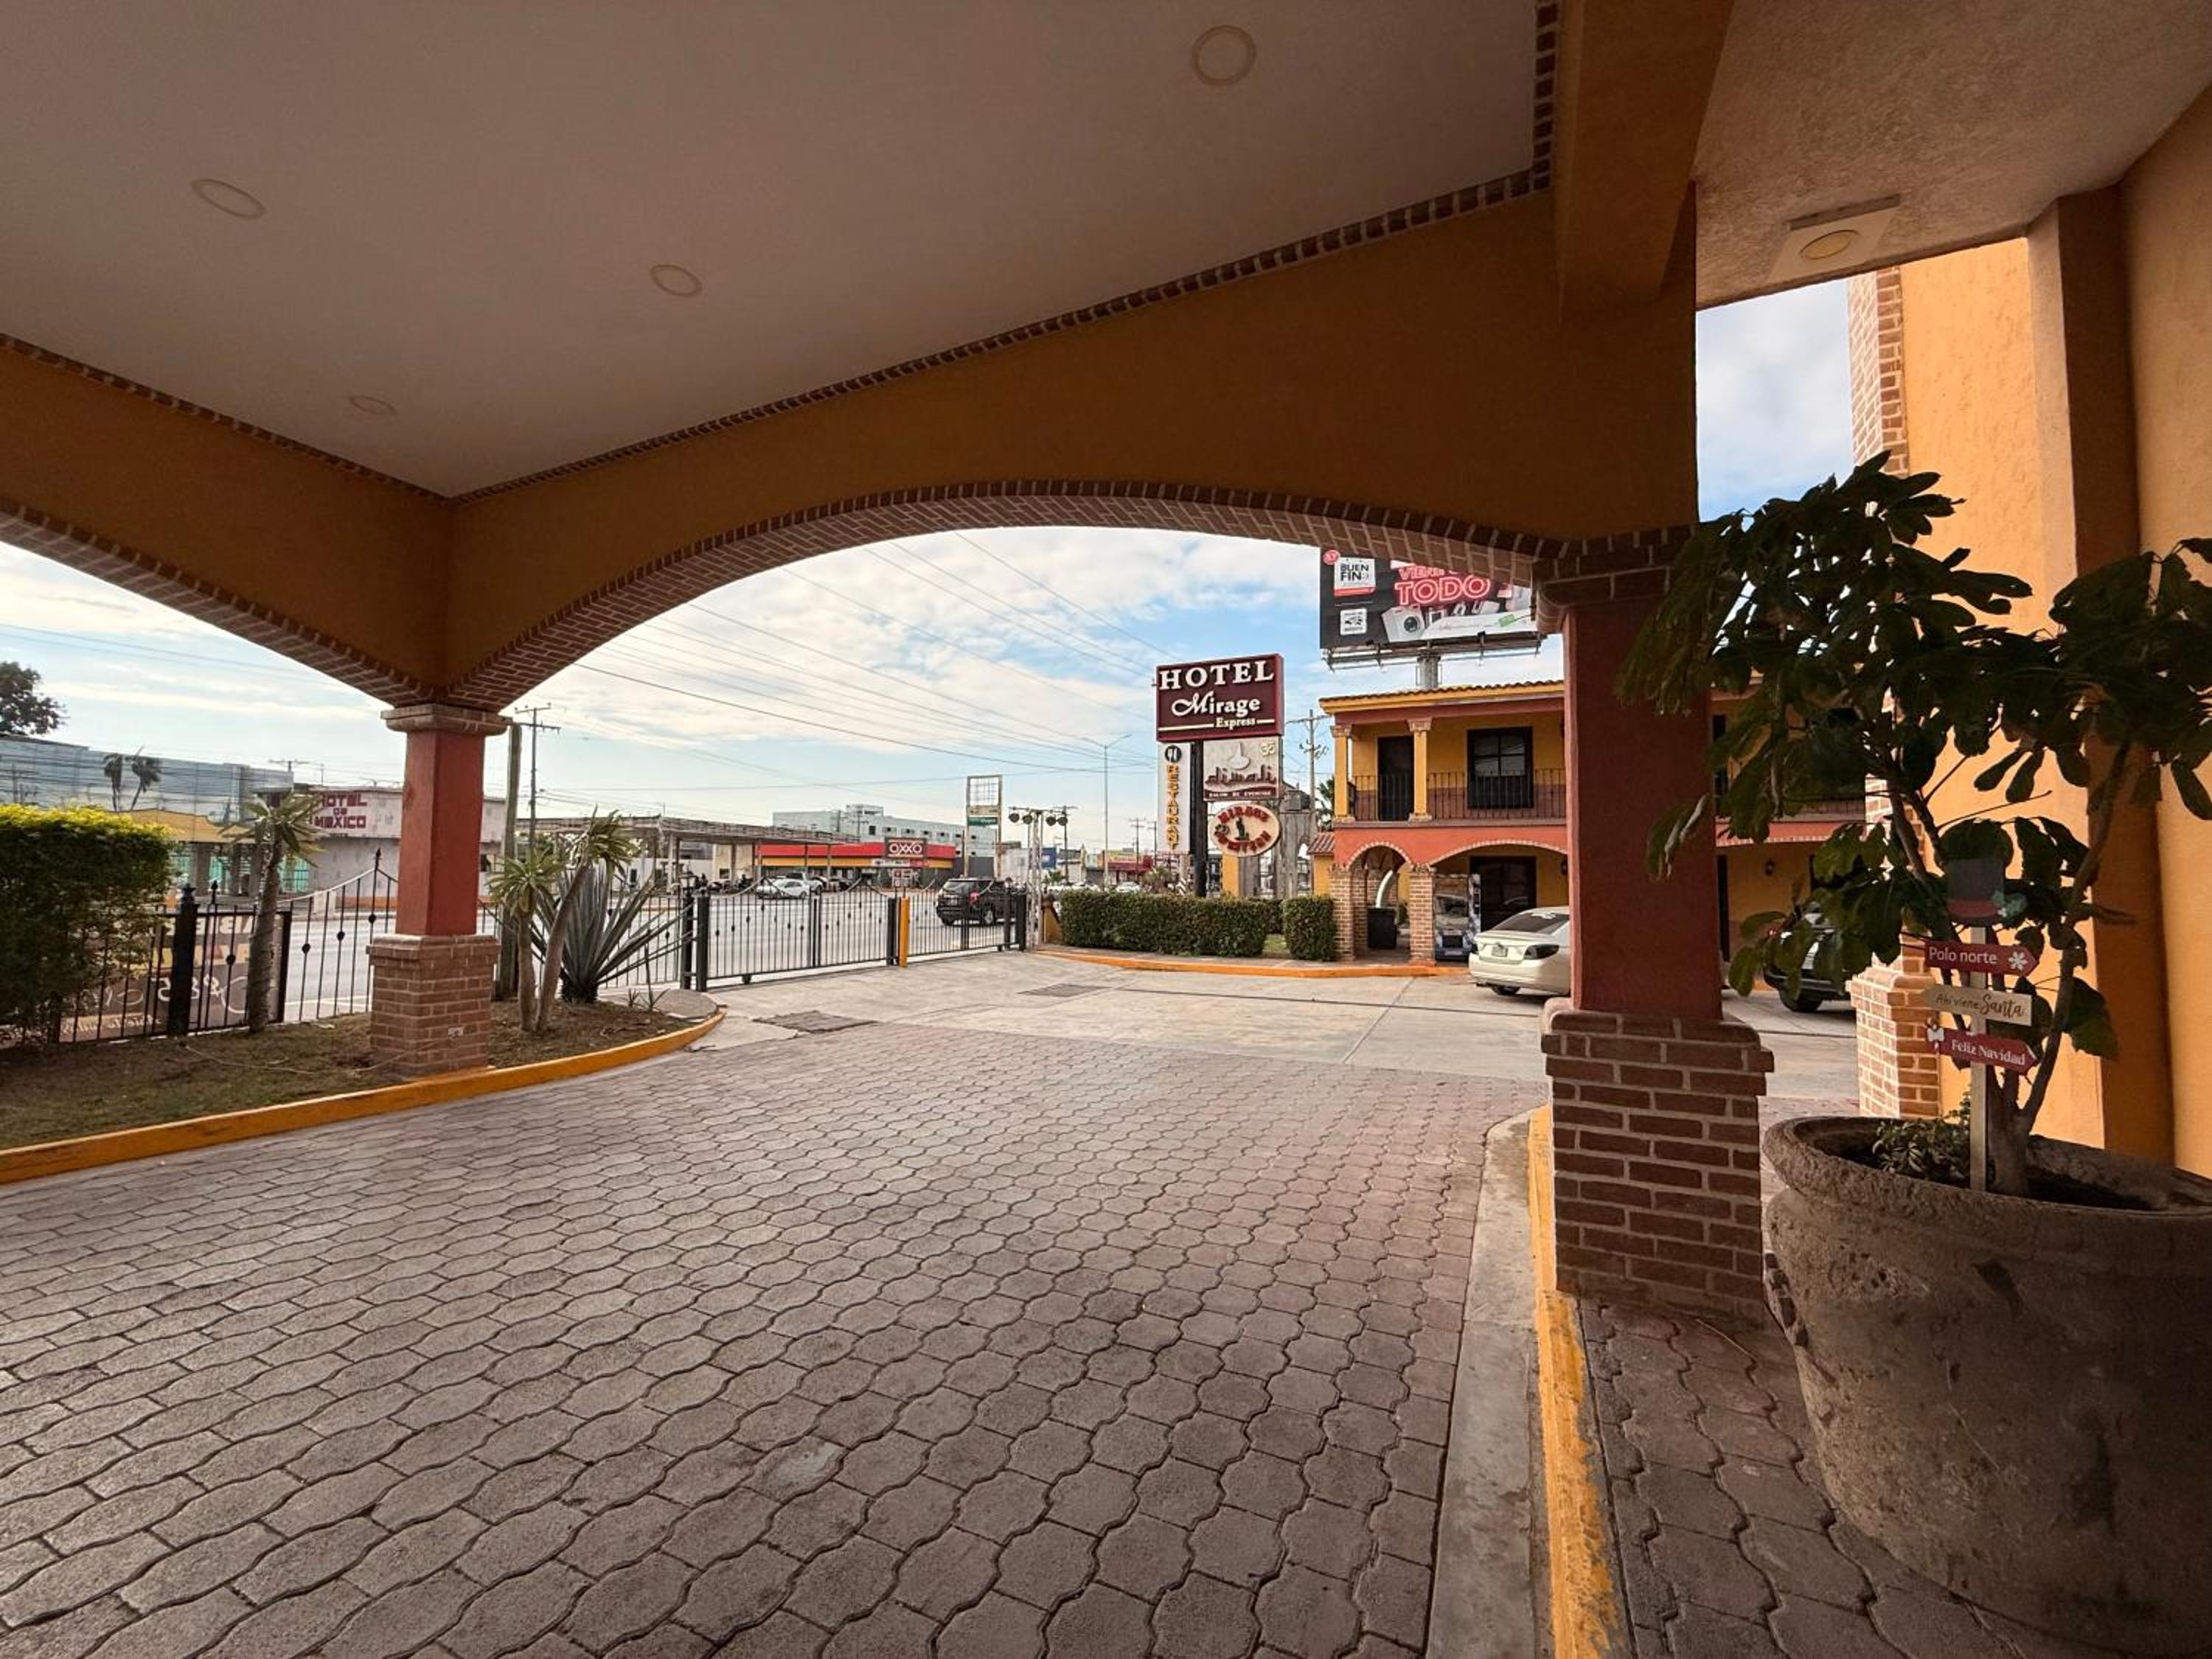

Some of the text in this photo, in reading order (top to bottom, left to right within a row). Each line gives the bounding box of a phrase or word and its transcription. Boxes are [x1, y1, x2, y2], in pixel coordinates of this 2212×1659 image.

[1340, 563, 1369, 571] BUEN
[1394, 574, 1491, 605] TODO
[1159, 661, 1274, 690] HOTEL
[1172, 690, 1260, 717] Mirage
[1216, 717, 1256, 730] Express
[315, 815, 366, 828] MEXICO
[888, 841, 923, 855] OXXO
[1929, 946, 1998, 964] Polo norte
[1980, 993, 2025, 1018] Santa
[1952, 1039, 2025, 1065] Feliz Navidad
